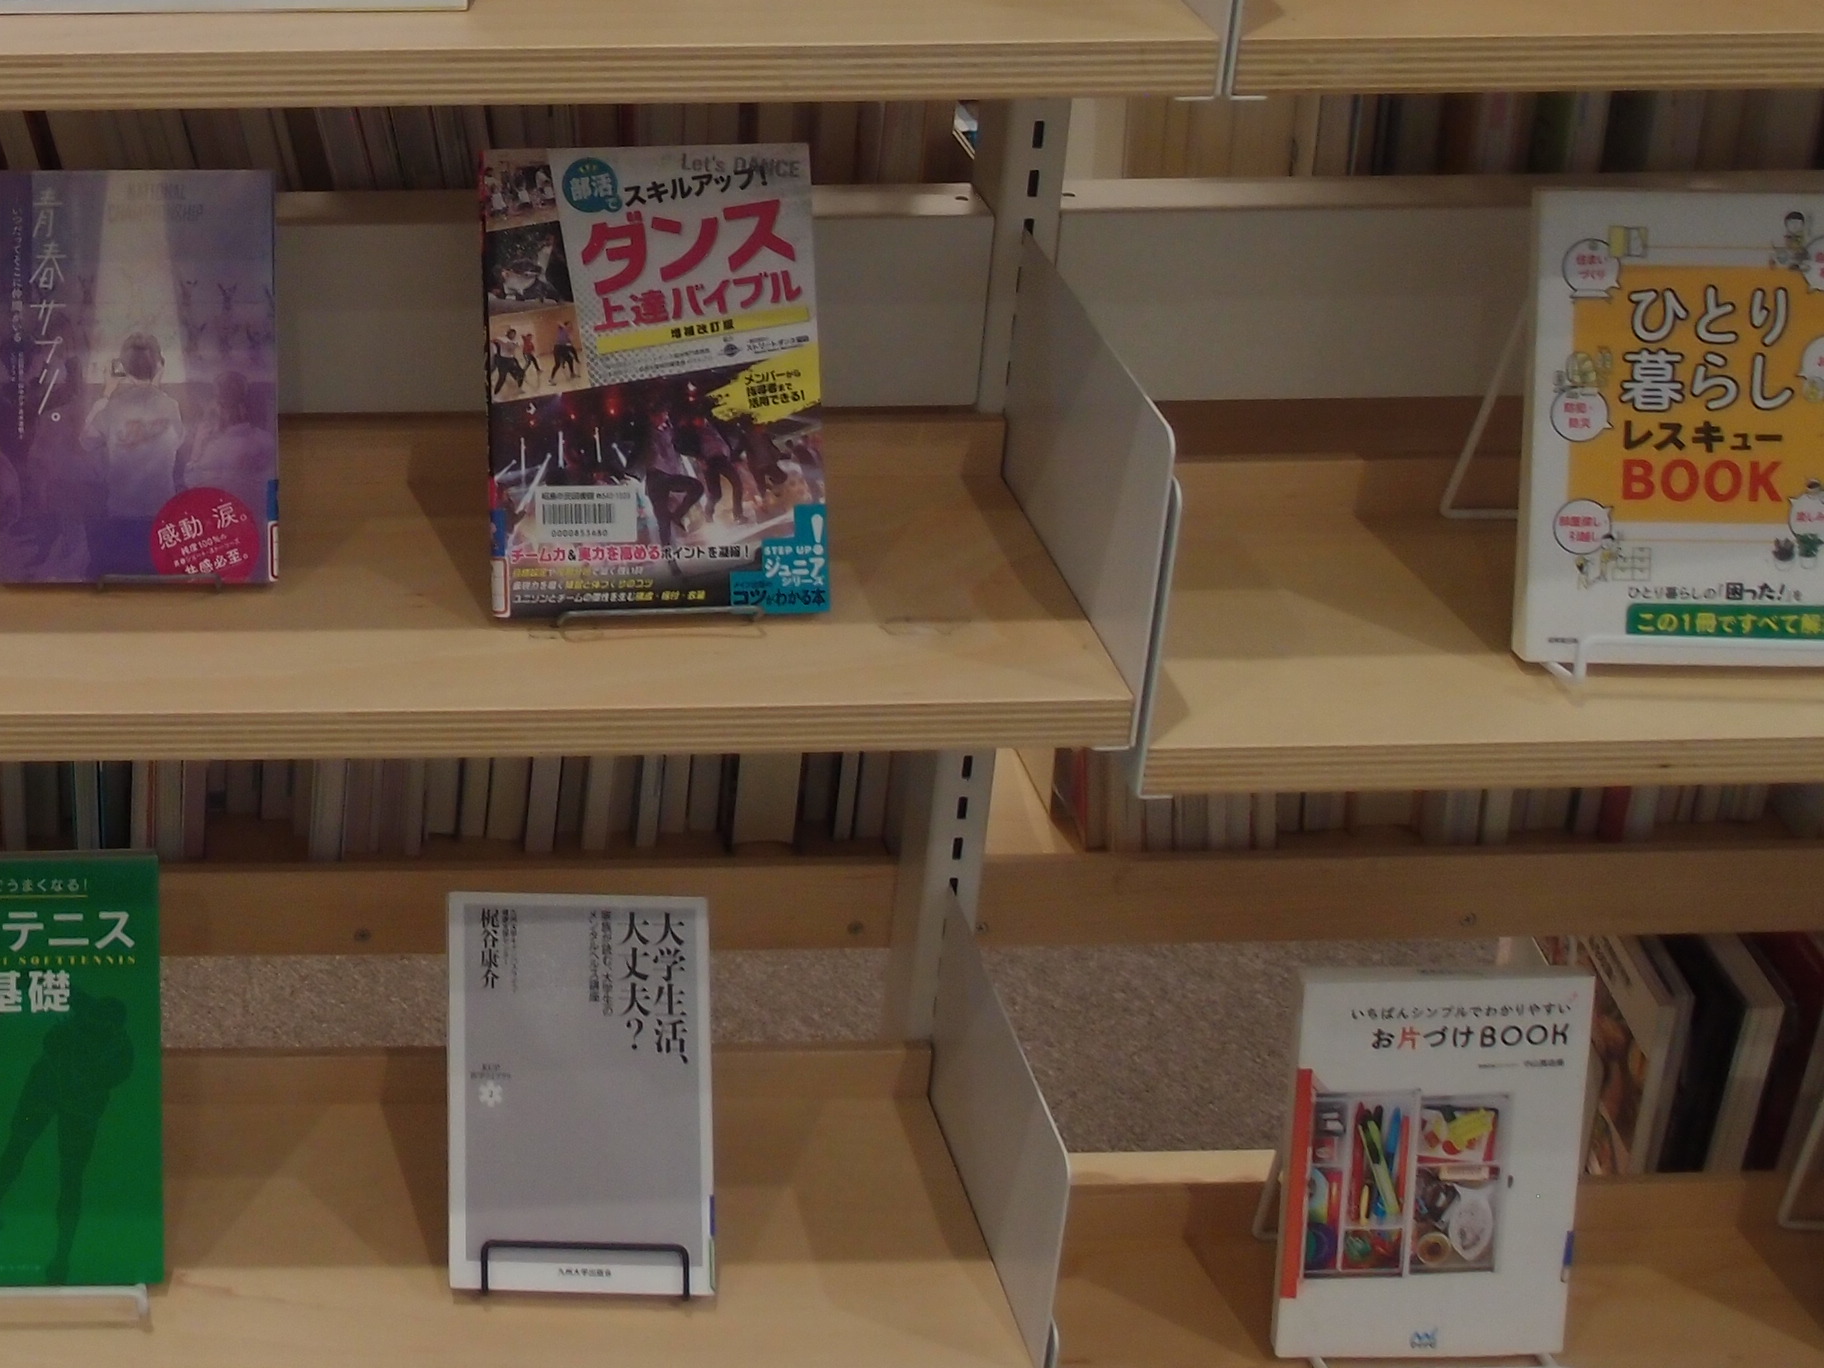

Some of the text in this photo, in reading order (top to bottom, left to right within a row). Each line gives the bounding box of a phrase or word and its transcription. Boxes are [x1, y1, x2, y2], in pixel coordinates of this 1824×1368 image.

[624, 164, 769, 208] スキルアップ！
[680, 151, 726, 173] Let's
[581, 198, 796, 296] ダンス
[594, 269, 803, 331] 上達バイブル
[1628, 283, 1789, 347] ひとり
[1618, 347, 1795, 413] 暮らし
[1624, 419, 1784, 453] レスキュー
[1621, 458, 1783, 503] BOOK
[764, 557, 826, 579] ジュニア
[617, 911, 651, 1051] 大丈夫？
[651, 911, 690, 1065] 大学生活、
[1371, 1022, 1571, 1051] お片づけBOOK
